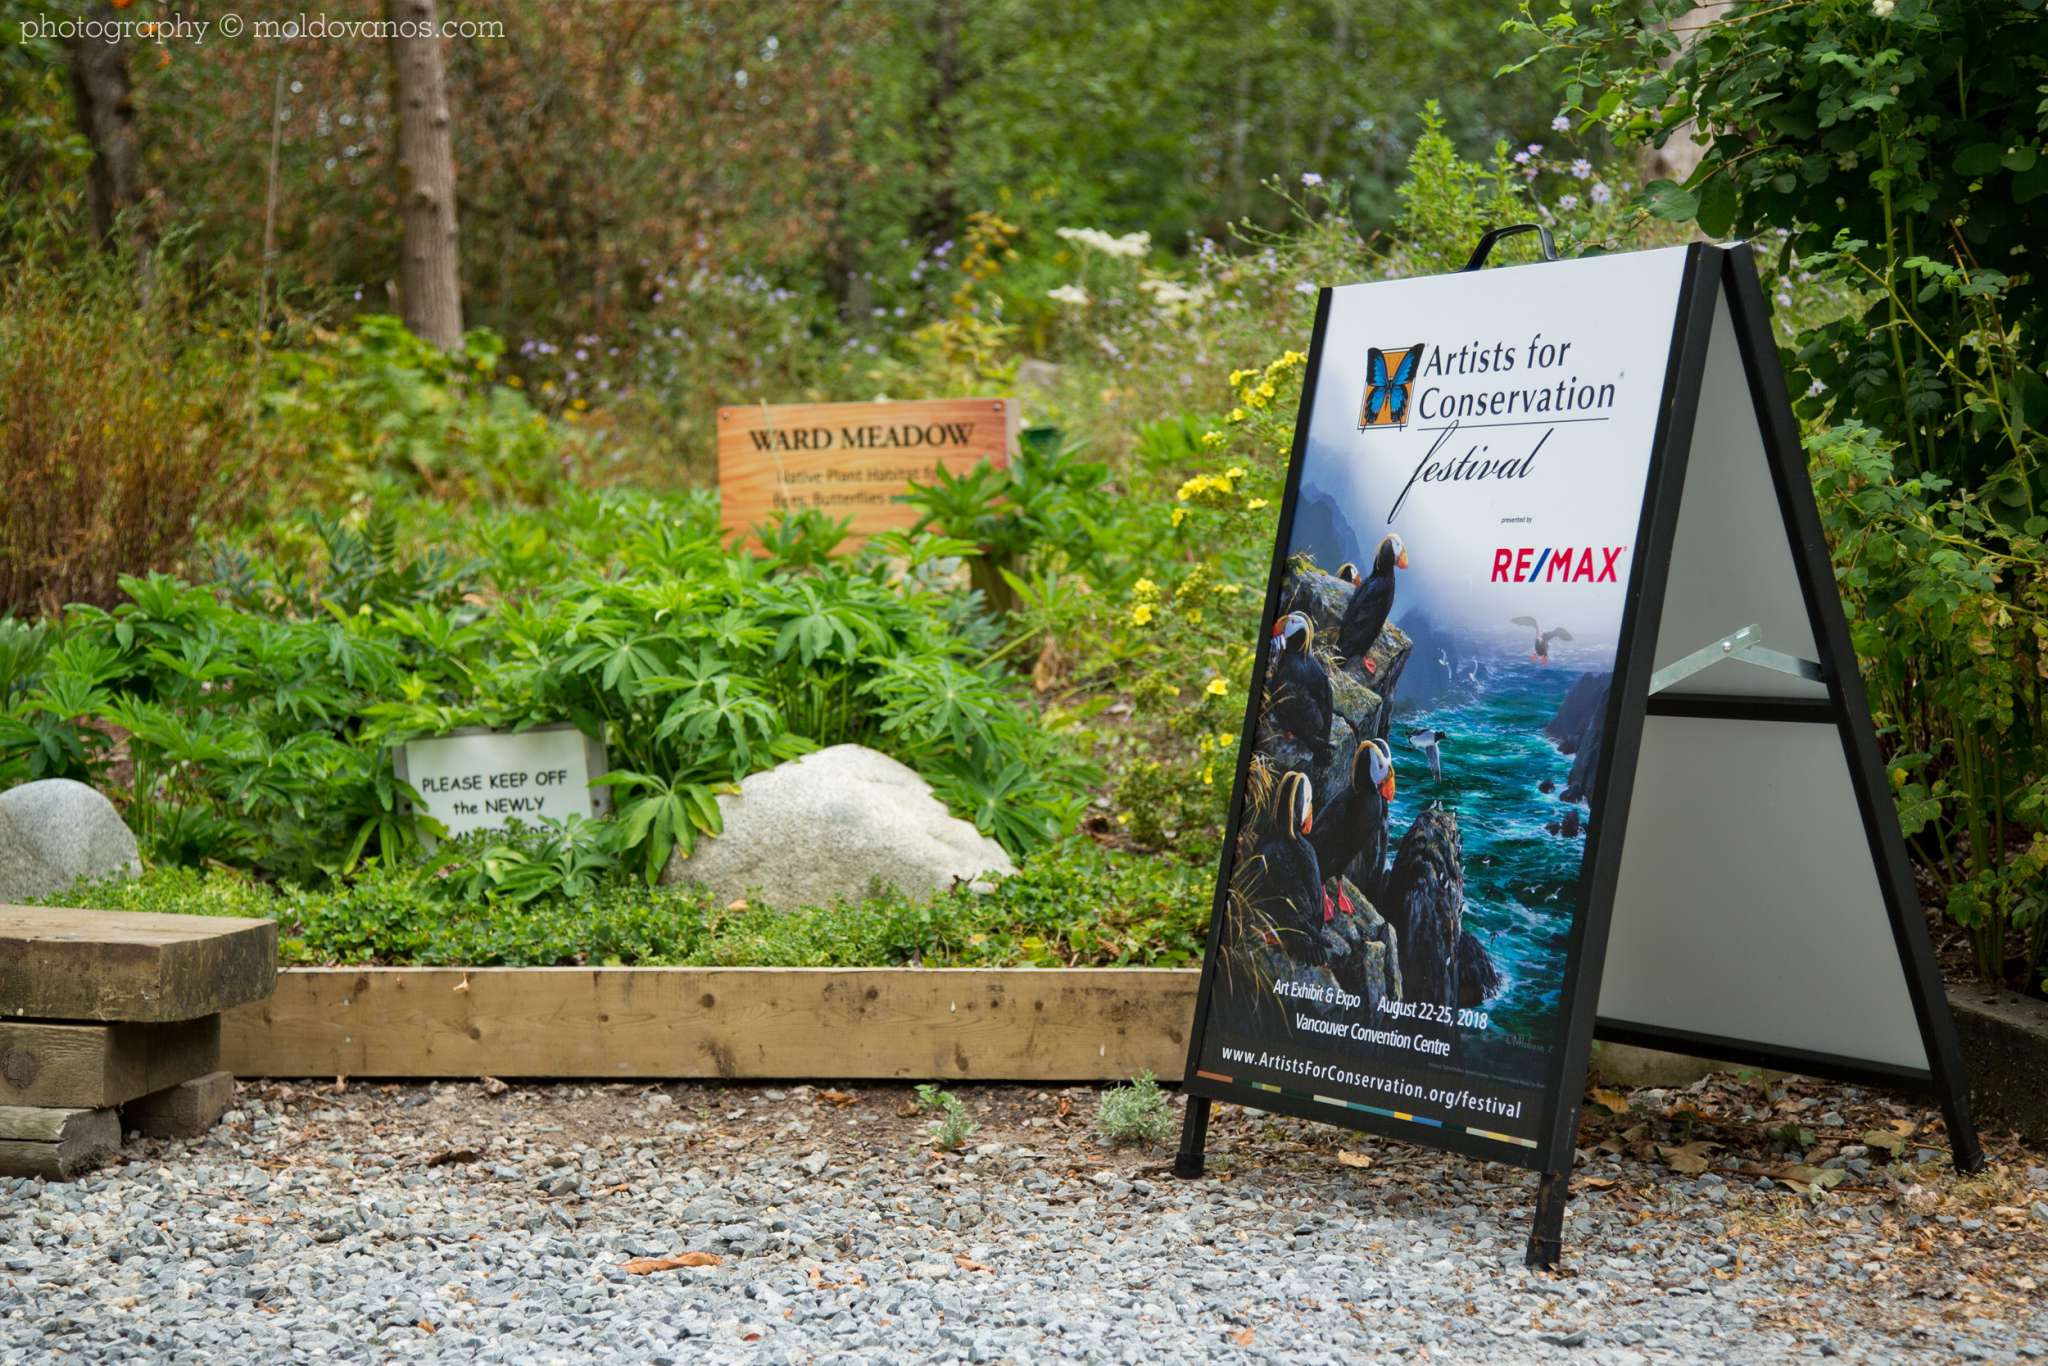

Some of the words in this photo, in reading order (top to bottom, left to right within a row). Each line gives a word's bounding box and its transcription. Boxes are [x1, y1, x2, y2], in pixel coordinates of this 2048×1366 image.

[1423, 340, 1516, 377] Artists
[1527, 333, 1572, 369] for
[1419, 376, 1615, 419] Conservation
[749, 427, 833, 451] WARD
[840, 422, 976, 448] MEADOW
[1386, 419, 1555, 525] festival
[1490, 547, 1623, 583] RE/MAX
[421, 775, 482, 793] PLEASE
[489, 773, 529, 789] KEEP
[535, 770, 568, 786] OFF
[452, 801, 478, 815] the
[485, 797, 545, 814] NEWLY
[1272, 978, 1290, 996] Art
[1290, 981, 1324, 1002] Exhibit
[1325, 987, 1334, 1004] &
[1335, 989, 1361, 1011] Expo
[1377, 996, 1418, 1020] August
[1418, 1002, 1454, 1027] 22-25,
[1457, 1008, 1489, 1030] 2018
[1295, 1012, 1350, 1037] Vancouver
[1350, 1022, 1411, 1049] Convention
[1413, 1034, 1451, 1056] Centre
[1221, 1045, 1522, 1119] www.ArtistsForConservation.org/festival
